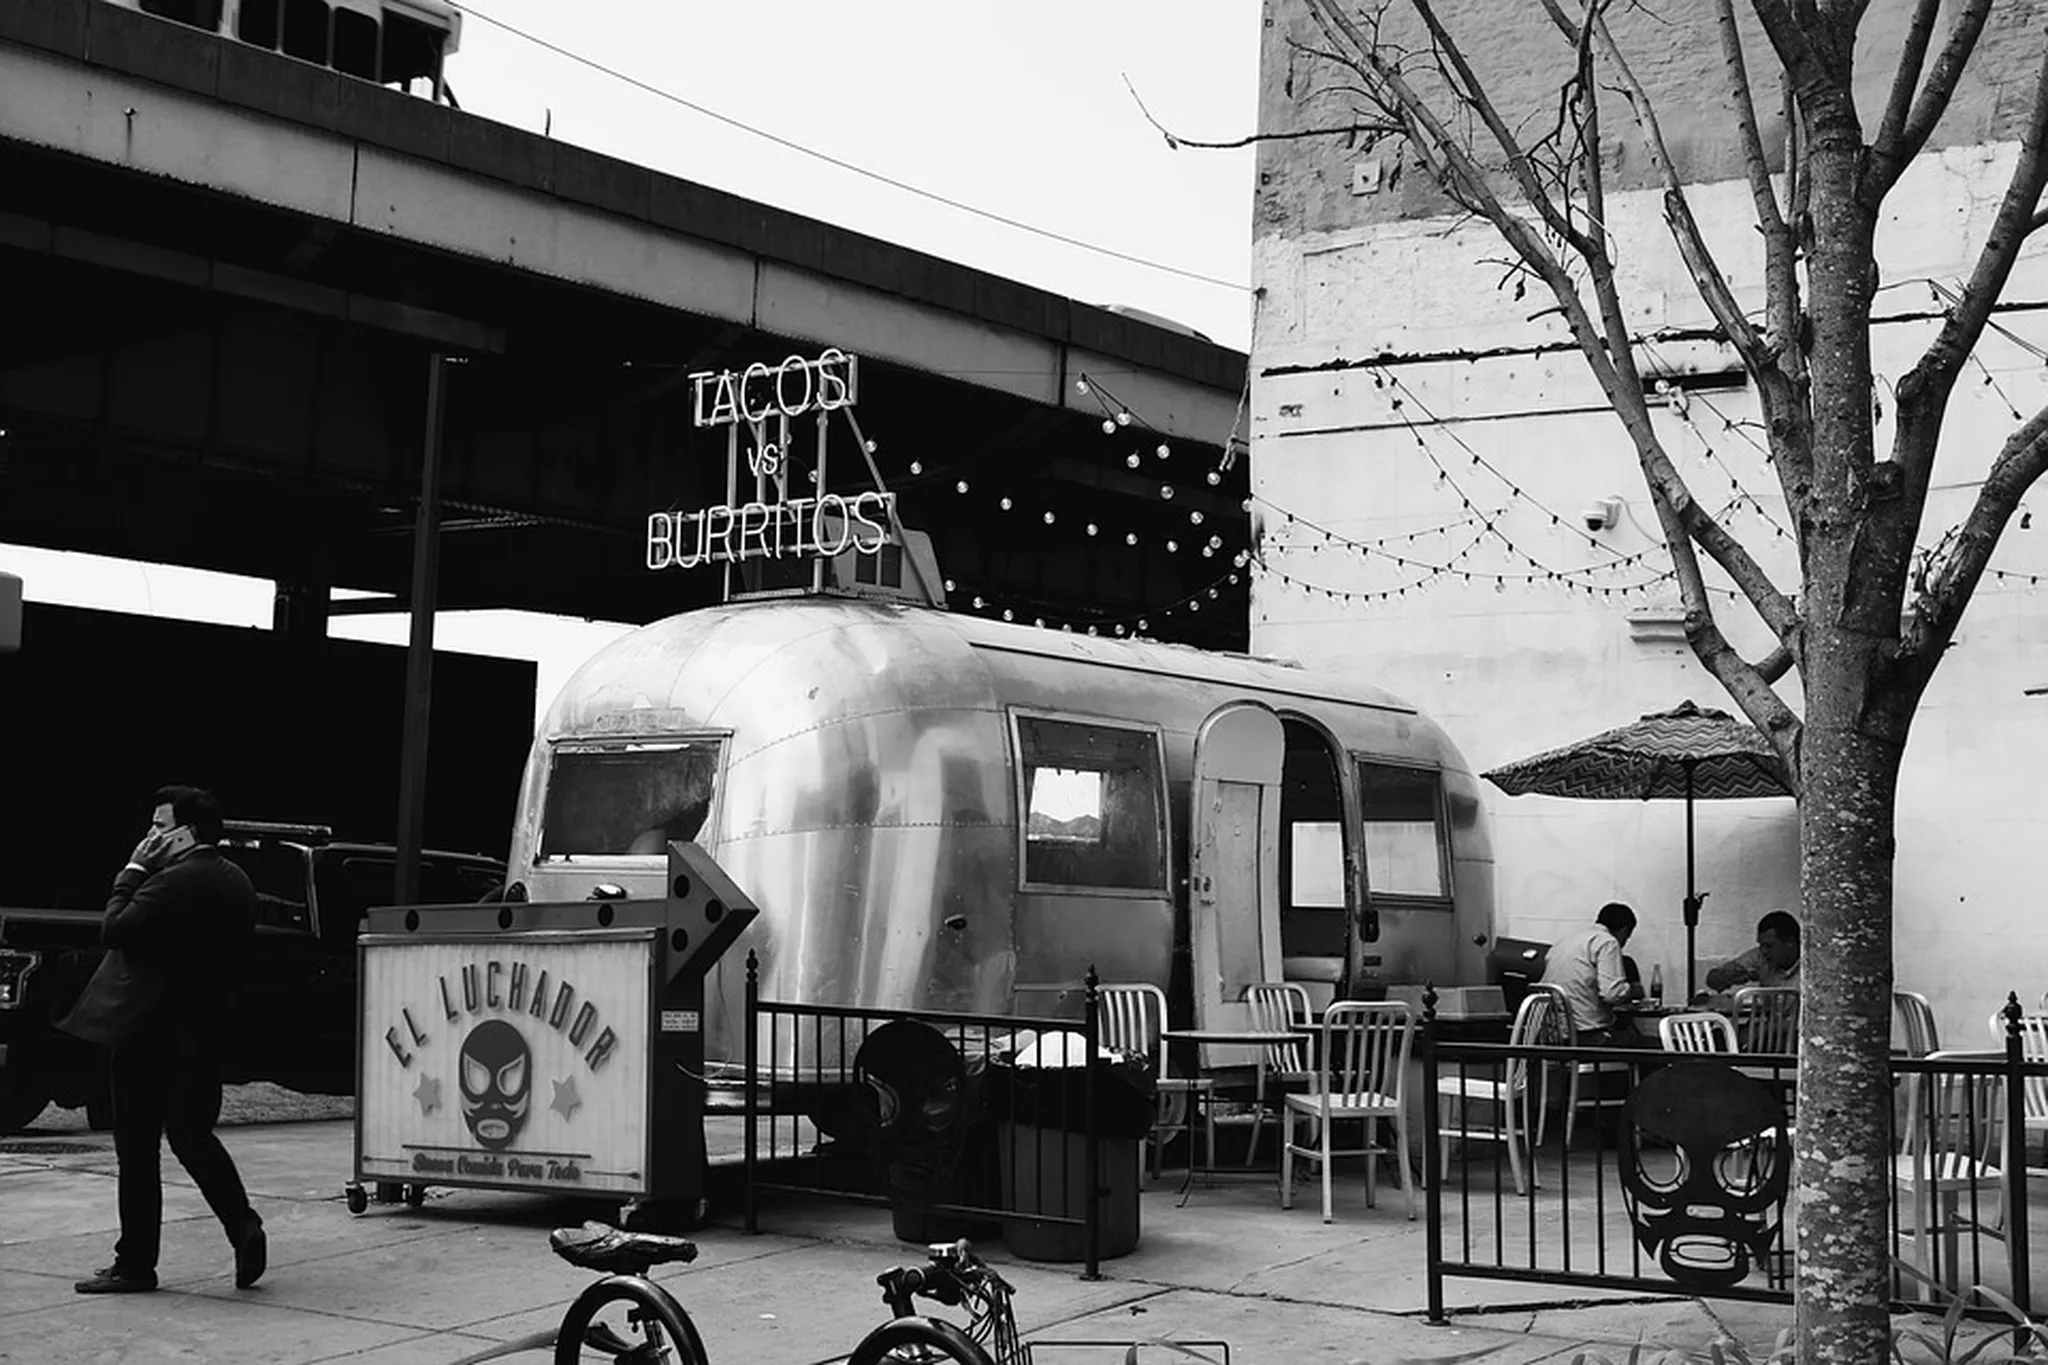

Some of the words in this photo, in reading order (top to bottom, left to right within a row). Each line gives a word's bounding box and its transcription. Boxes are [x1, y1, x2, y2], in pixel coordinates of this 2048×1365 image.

[688, 348, 846, 426] TACOS
[646, 491, 884, 570] BURRITOS
[385, 1007, 427, 1068] EL
[439, 961, 617, 1071] LUCHADOR
